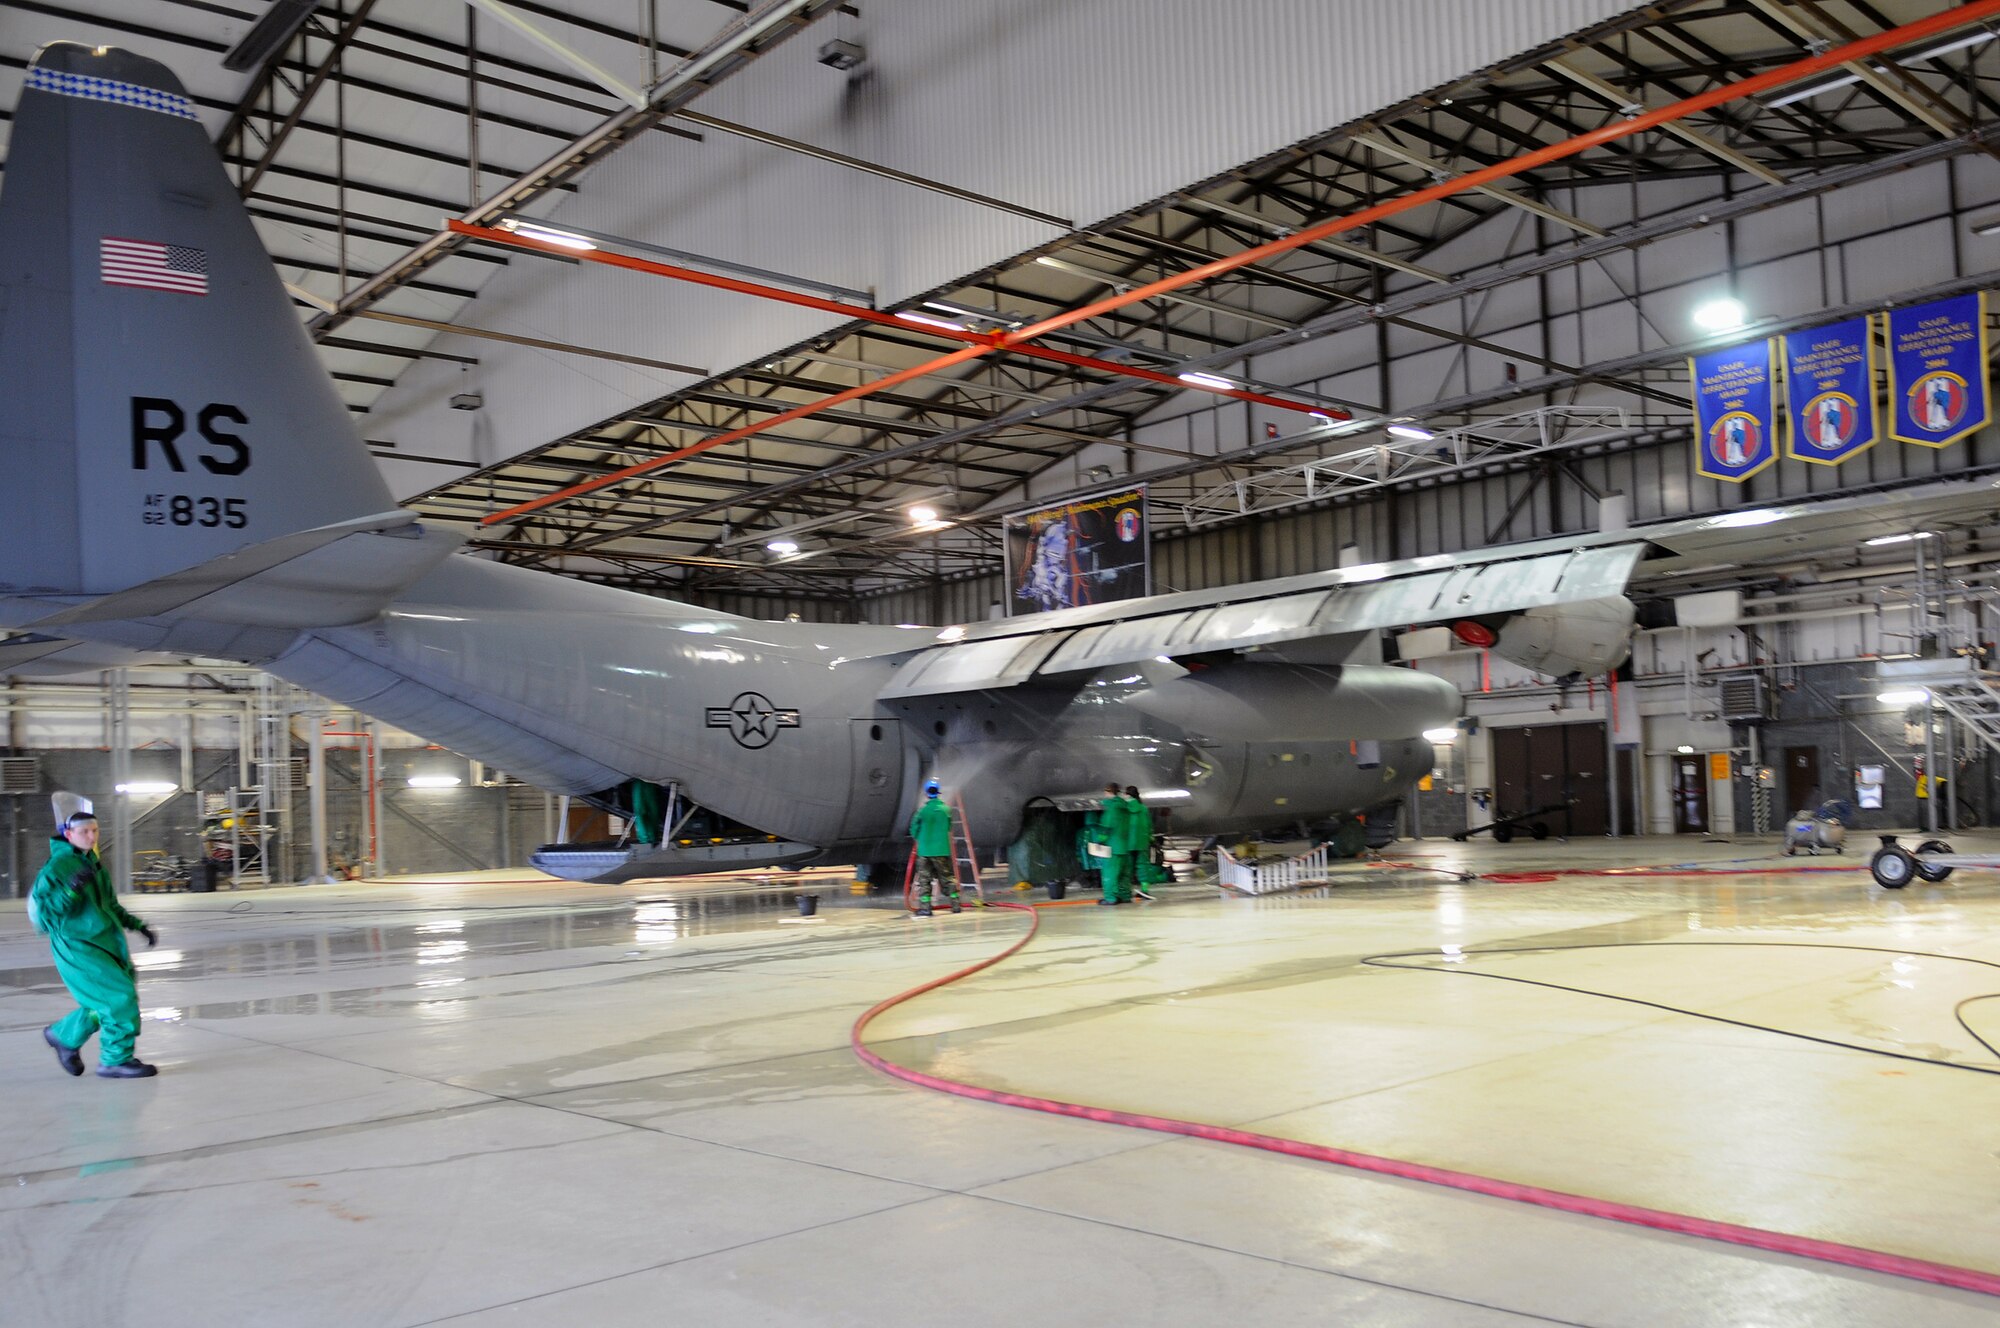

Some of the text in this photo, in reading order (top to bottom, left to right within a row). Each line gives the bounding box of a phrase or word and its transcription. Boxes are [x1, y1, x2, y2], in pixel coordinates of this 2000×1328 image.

[1899, 321, 1971, 342] MAINTENANCE
[1794, 343, 1859, 363] MAINTENANCE
[1920, 345, 1954, 358] AWARD
[1703, 366, 1762, 384] MAINTENANCE
[1813, 367, 1845, 378] AWARD
[1719, 388, 1749, 399] AWARD
[131, 396, 250, 475] RS
[144, 493, 166, 507] AF
[143, 512, 166, 525] 62
[170, 495, 248, 529] 835
